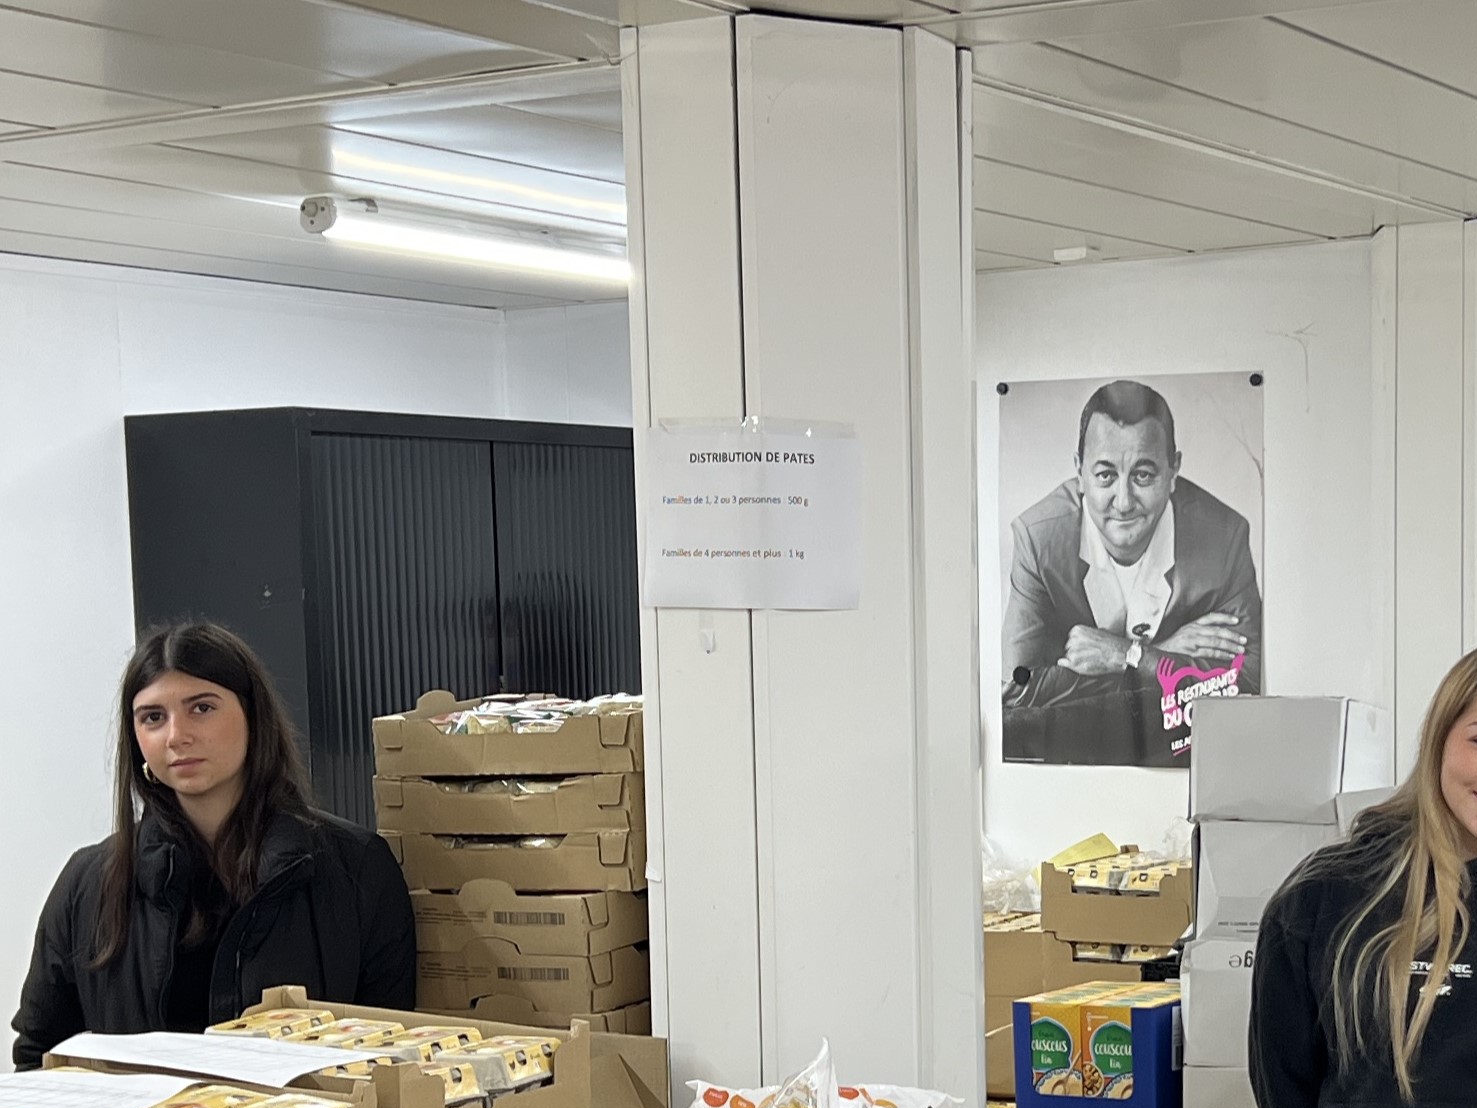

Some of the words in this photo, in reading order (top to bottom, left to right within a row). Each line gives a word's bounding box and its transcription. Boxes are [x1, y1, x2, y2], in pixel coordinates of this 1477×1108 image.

[689, 451, 762, 464] DISTRIBUTION
[765, 452, 780, 463] DE
[783, 452, 815, 465] PATES
[662, 495, 692, 504] Familles
[693, 495, 704, 504] de
[713, 496, 719, 504] 2
[731, 495, 737, 504] 3
[738, 496, 782, 506] personnes
[787, 496, 803, 505] 500
[661, 549, 692, 558] Familles
[692, 549, 703, 558] de
[704, 549, 710, 557] 4
[710, 550, 751, 559] personnes
[752, 549, 762, 558] et
[763, 548, 782, 559] plus
[795, 549, 805, 560] kg
[1160, 693, 1176, 712] LES
[1177, 667, 1238, 706] RESTAURANTS
[1163, 706, 1183, 730] DU
